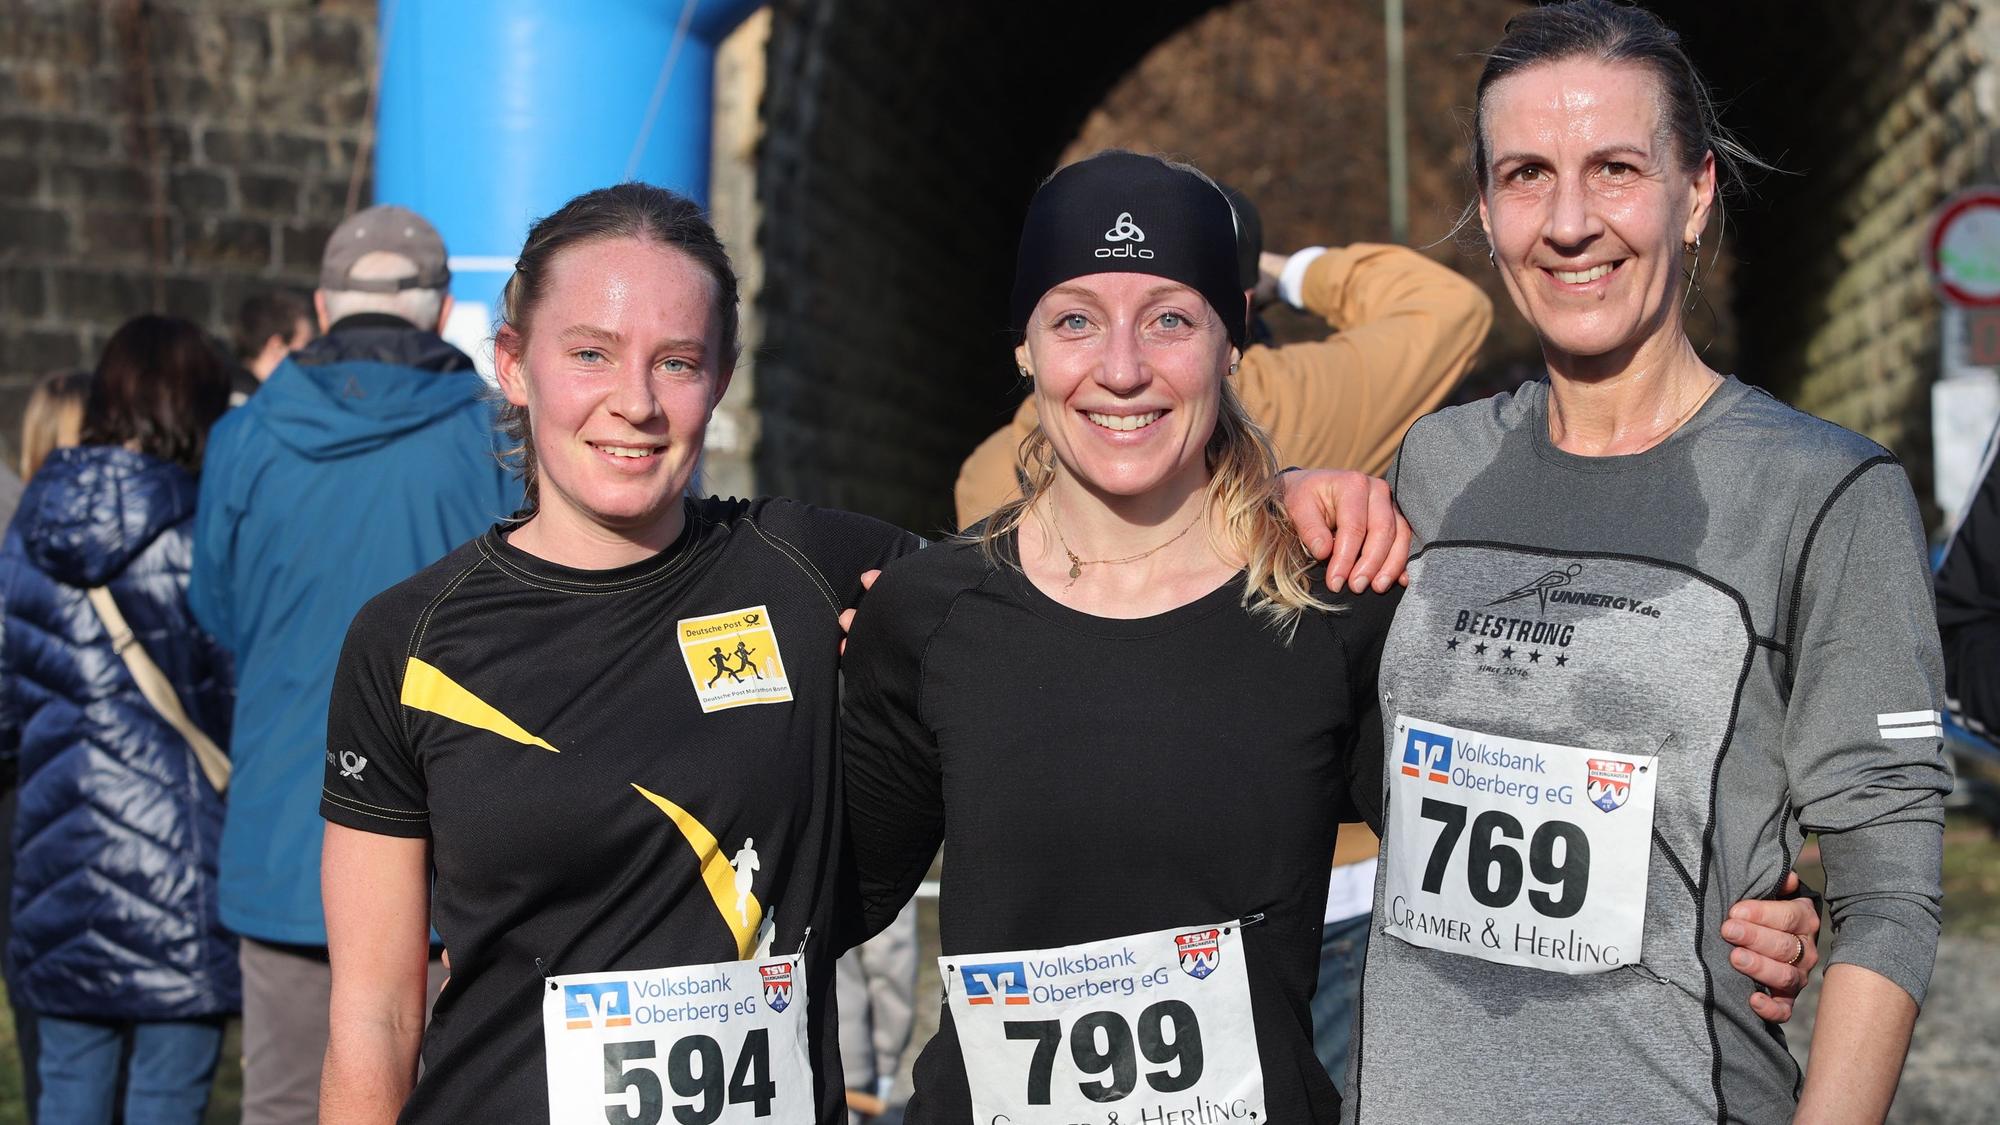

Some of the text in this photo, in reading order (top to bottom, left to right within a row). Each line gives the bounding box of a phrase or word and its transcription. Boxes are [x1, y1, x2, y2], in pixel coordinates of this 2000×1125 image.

[1095, 244, 1154, 259] odlo
[686, 620, 742, 637] Deutsche Post
[1455, 610, 1575, 647] BEESTRONG
[703, 693, 731, 703] Deutsche
[1456, 741, 1546, 775] Volksbank
[1595, 761, 1626, 773] TSV
[1452, 767, 1573, 806] Oberberg eG
[1420, 797, 1591, 919] 769
[1183, 931, 1210, 943] TSV
[1392, 895, 1471, 944] CRAMER
[1481, 917, 1501, 950] &
[765, 965, 785, 975] TSV
[1029, 947, 1137, 979] Volksbank
[633, 973, 732, 998] Volksbank
[1032, 966, 1170, 1004] Oberberg eG
[635, 1002, 729, 1025] Oberberg
[735, 996, 756, 1016] eG
[1003, 999, 1204, 1106] 799
[603, 1027, 776, 1125] 594
